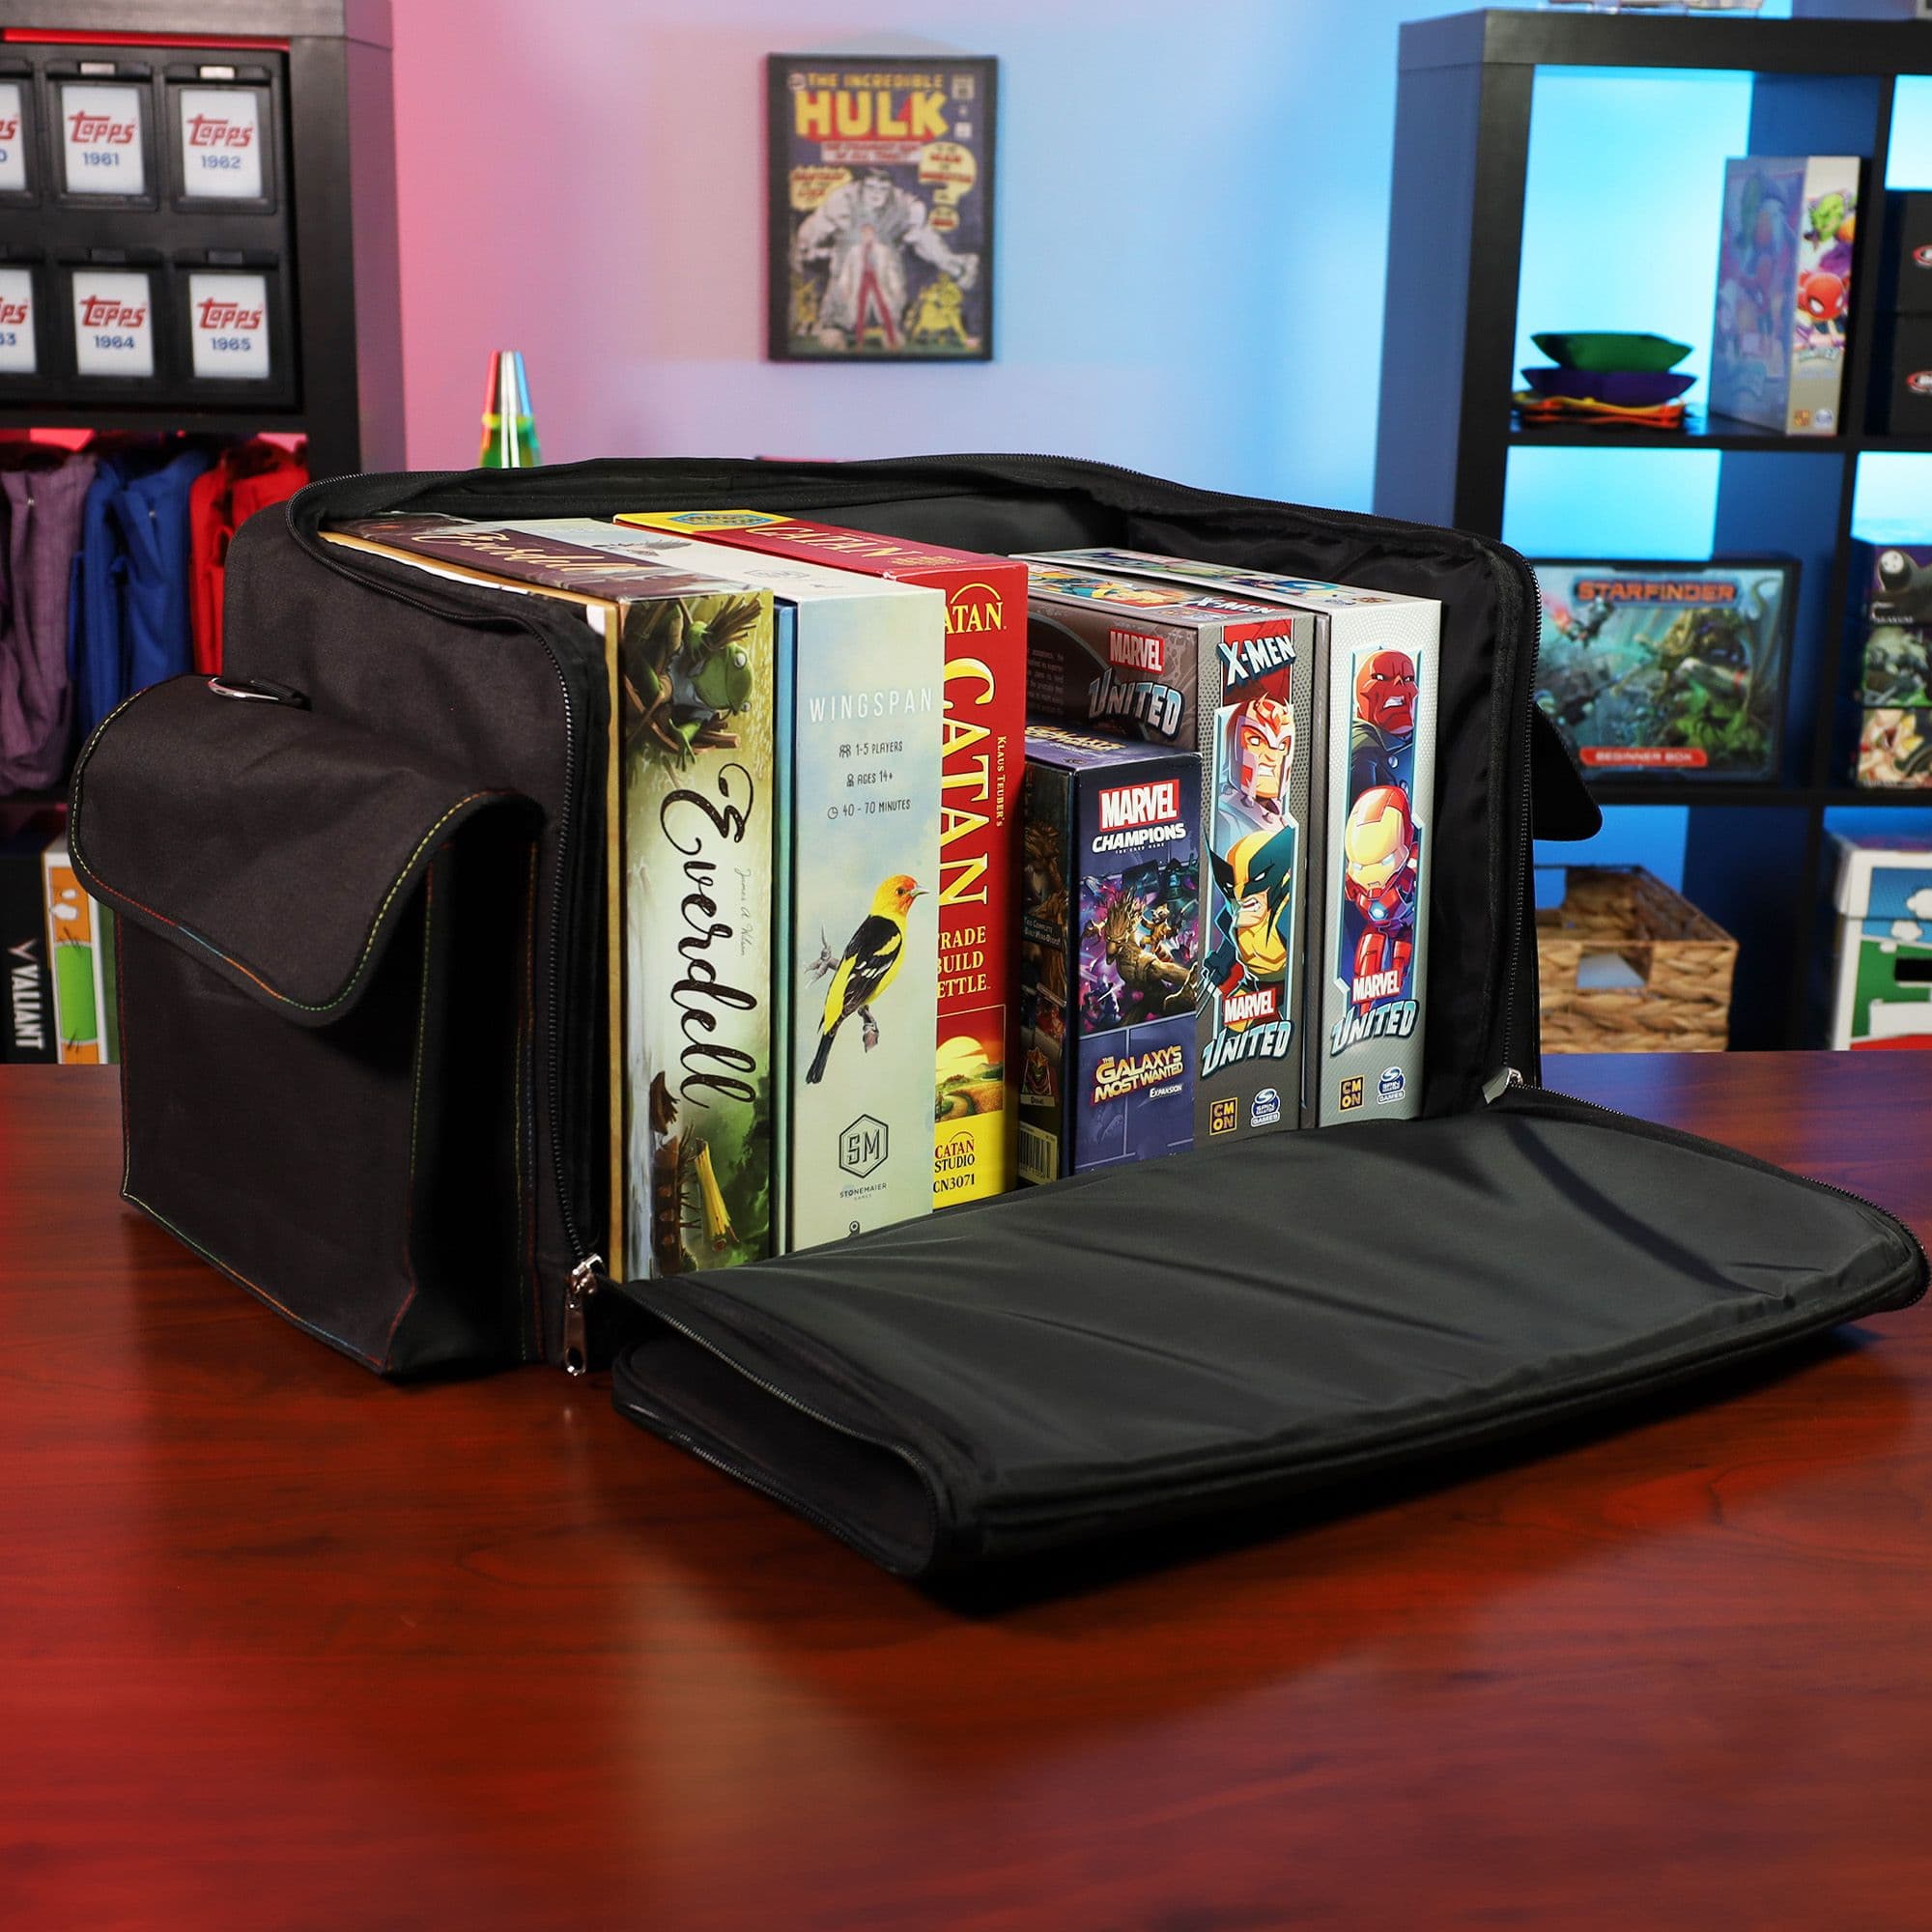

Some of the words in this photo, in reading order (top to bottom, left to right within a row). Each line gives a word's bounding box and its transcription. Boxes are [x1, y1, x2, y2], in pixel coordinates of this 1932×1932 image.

[808, 72, 838, 88] THE
[843, 72, 944, 90] INCREDIBLE
[794, 90, 949, 138] HULK
[83, 152, 120, 166] 1961
[201, 155, 241, 170] 1962
[94, 335, 135, 350] 1964
[211, 337, 251, 352] 1965
[745, 526, 923, 557] CATAN
[1577, 581, 1737, 603] STARFINDER
[944, 602, 1004, 635] ATAN
[1110, 630, 1163, 672] MARVEL
[1216, 635, 1297, 686] X-MEN
[809, 687, 934, 724] WINGSPAN
[1088, 667, 1184, 737] UNITED
[855, 743, 869, 755] 1-5
[871, 740, 903, 754] PLAYERS
[997, 735, 1007, 773] KLAUS
[1664, 750, 1695, 764] BOX
[857, 773, 876, 785] AGES
[939, 656, 996, 907] CATAN
[842, 803, 855, 816] 40
[865, 801, 876, 813] 70
[878, 799, 911, 812] MINUTES
[1100, 782, 1178, 830] MARVEL
[1092, 822, 1187, 853] CHAMPIONS
[660, 762, 758, 1109] Everdell
[937, 925, 986, 951] RADE
[937, 974, 987, 999] ETTLE
[1351, 970, 1401, 1003] MARVEL
[11, 964, 45, 1051] VALIANT
[1224, 989, 1275, 1026] MARVEL
[1330, 1000, 1418, 1056] UNITED
[1095, 1045, 1182, 1084] GALAXY'S
[1201, 1020, 1293, 1078] UNITED
[1094, 1073, 1140, 1103] MOST
[1139, 1062, 1184, 1087] WANTED
[846, 1128, 881, 1166] SM
[934, 1138, 976, 1160] CATAN
[934, 1153, 976, 1174] STUDIO
[838, 1182, 888, 1199] STONEMAIER
[933, 1173, 976, 1194] CN3071
